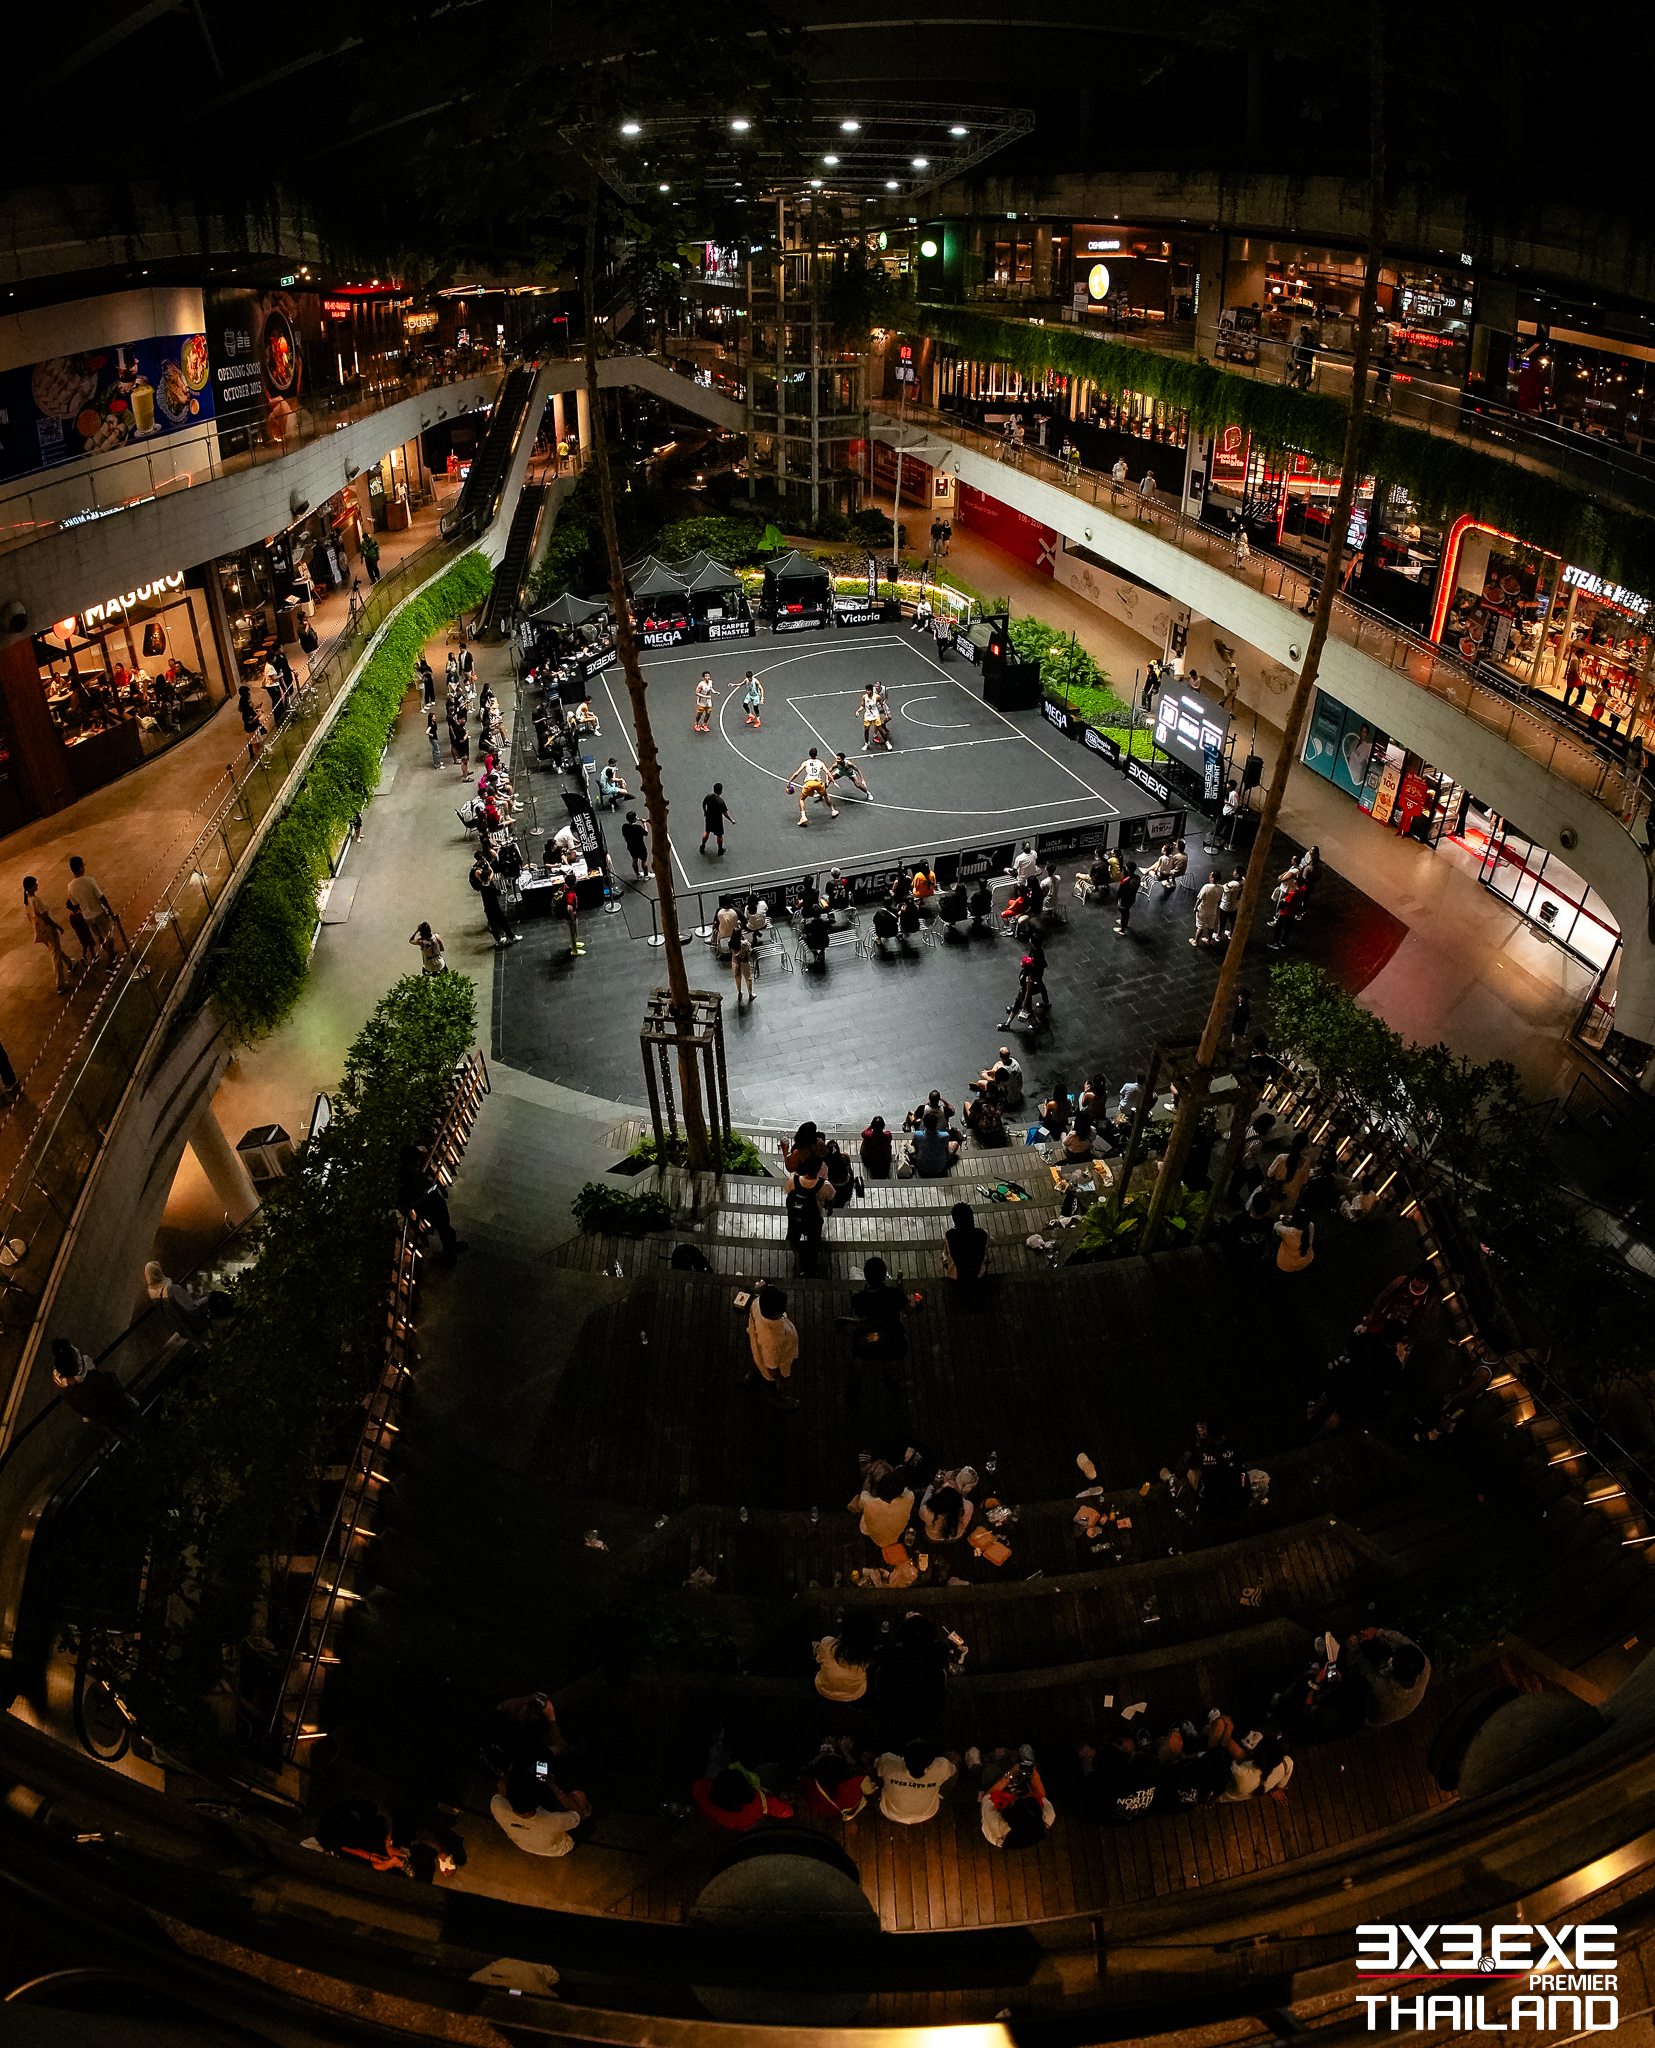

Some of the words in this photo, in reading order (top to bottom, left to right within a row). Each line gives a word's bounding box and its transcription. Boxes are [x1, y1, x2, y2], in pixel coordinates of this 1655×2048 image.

[217, 364, 246, 382] OPENING
[246, 362, 261, 377] SOON
[223, 384, 250, 402] OCTOBER
[841, 612, 880, 623] Victoria
[721, 621, 750, 630] CARPET
[721, 628, 750, 636] MASTER
[644, 631, 682, 646] MEGA
[1044, 700, 1068, 728] MEGA
[1383, 777, 1395, 791] 100
[1039, 844, 1068, 855] PARTNER
[832, 889, 846, 899] 74
[1136, 1786, 1156, 1798] THE
[1116, 1793, 1155, 1806] NORTH
[1125, 1801, 1151, 1811] FACE
